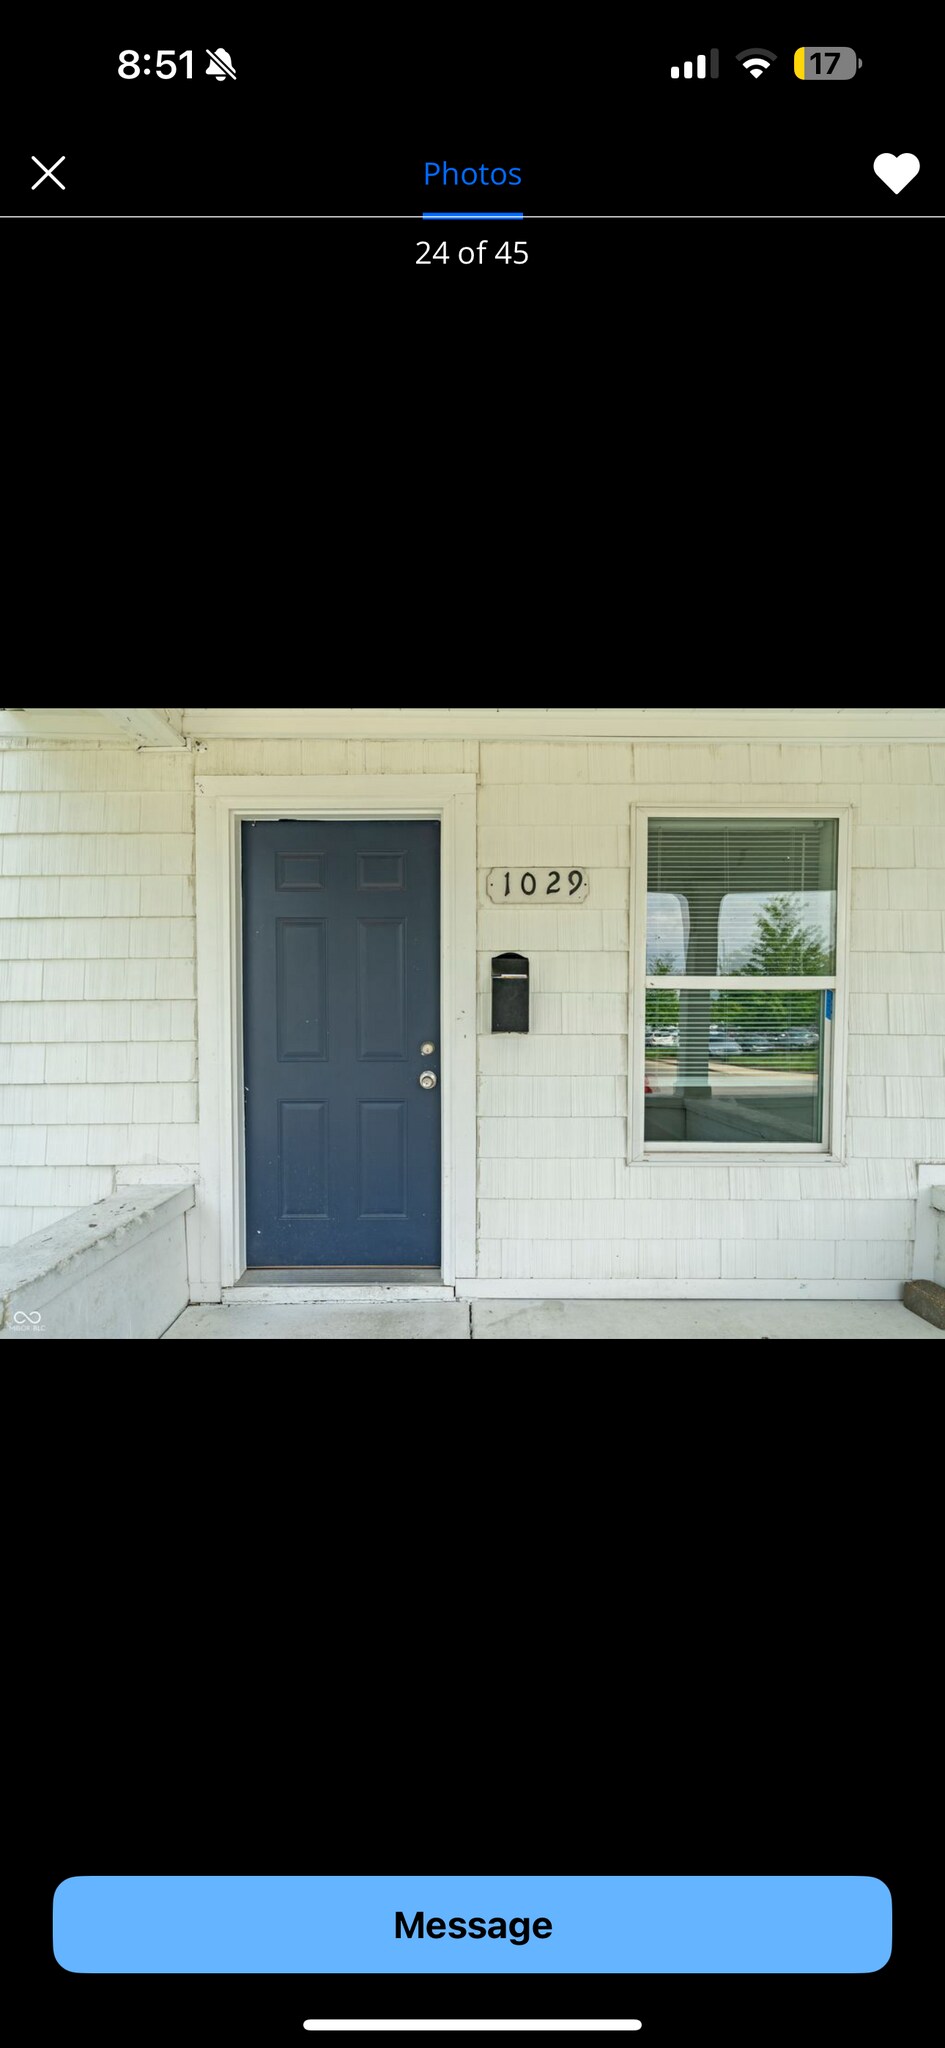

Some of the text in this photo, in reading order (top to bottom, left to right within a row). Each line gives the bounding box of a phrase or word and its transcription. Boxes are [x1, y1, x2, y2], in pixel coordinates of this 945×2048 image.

[117, 49, 194, 80] 8:51
[810, 52, 841, 75] 17
[423, 160, 522, 186] Photos
[415, 239, 529, 265] 24 of 45
[503, 869, 583, 897] 1029
[394, 1911, 553, 1946] Message
